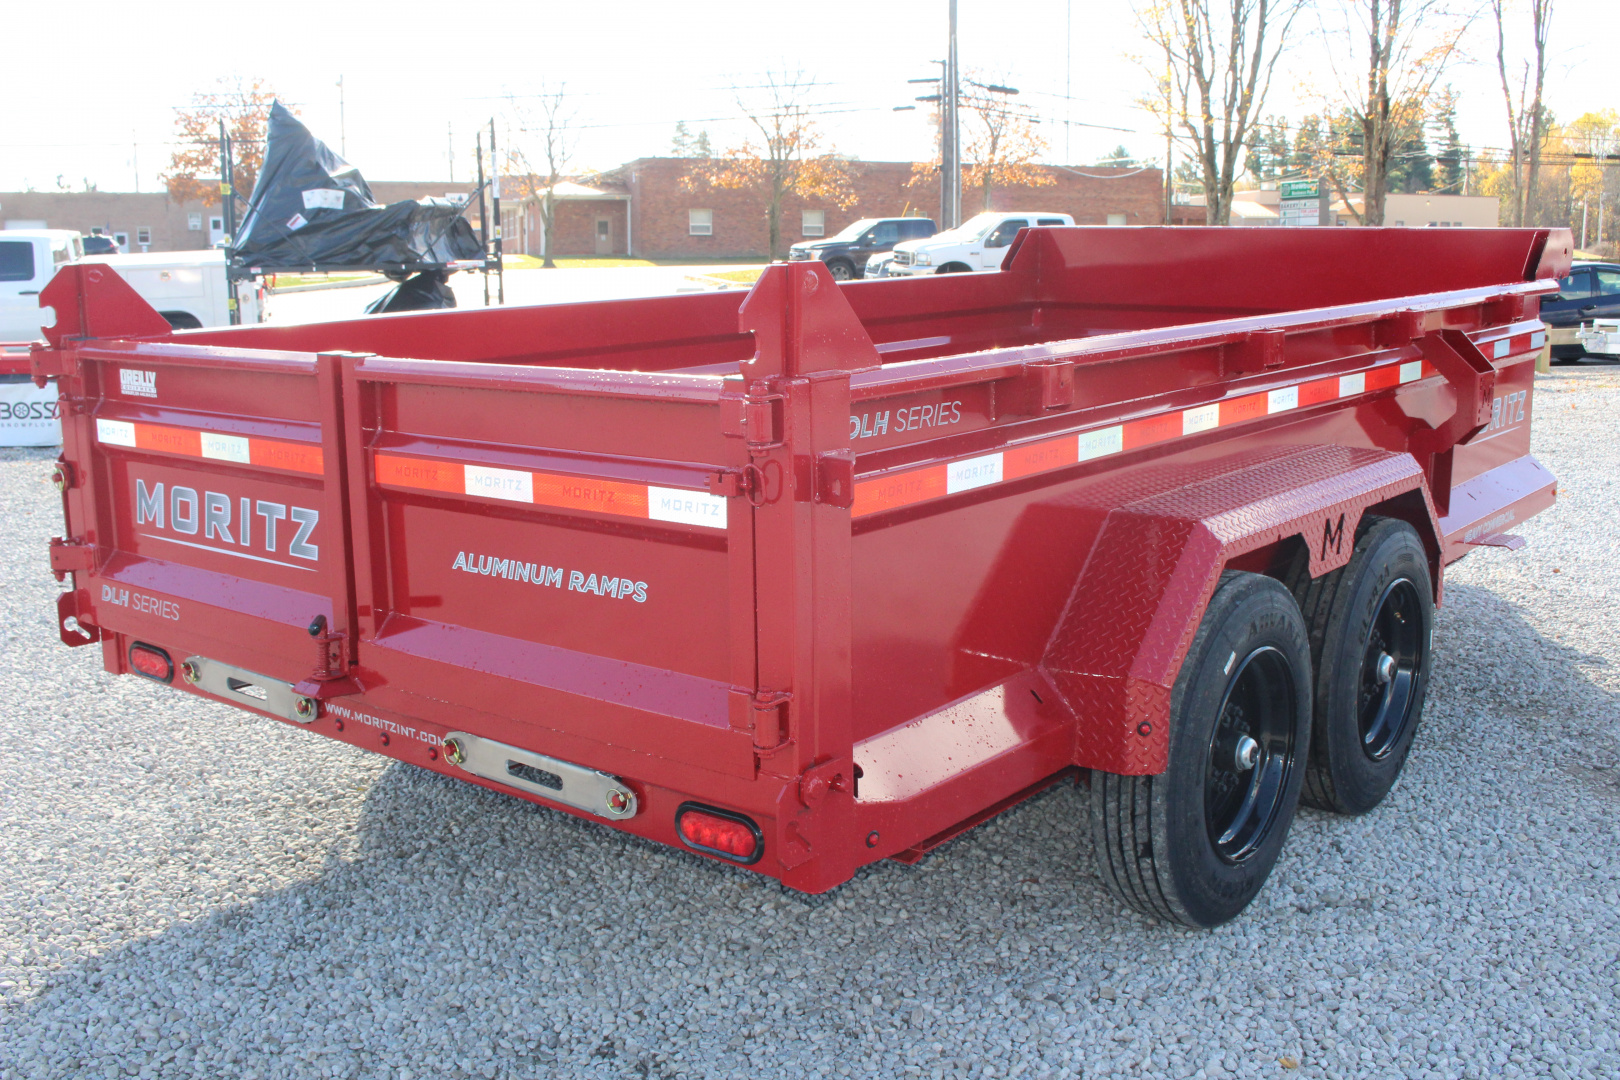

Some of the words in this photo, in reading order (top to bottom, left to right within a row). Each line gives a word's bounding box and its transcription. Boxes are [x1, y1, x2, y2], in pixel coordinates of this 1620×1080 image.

[0, 401, 56, 420] BOSS
[894, 401, 962, 432] SERIES
[1479, 390, 1527, 434] RITZ
[100, 426, 129, 438] MORITZ
[151, 432, 183, 446] MORITZ
[208, 440, 242, 454] MORITZ
[956, 463, 996, 481] MORITZ
[1085, 434, 1116, 449] MORITZ
[1188, 411, 1215, 426] MORITZ
[395, 465, 438, 481] MORITZ
[475, 475, 522, 491] MORITZ
[562, 484, 616, 502] MORITZ
[661, 498, 720, 516] MORITZ
[137, 479, 319, 561] MORITZ
[452, 551, 564, 588] ALUMINUM
[568, 570, 649, 603] RAMPS
[101, 584, 130, 608] DLH
[132, 593, 180, 621] SERIES
